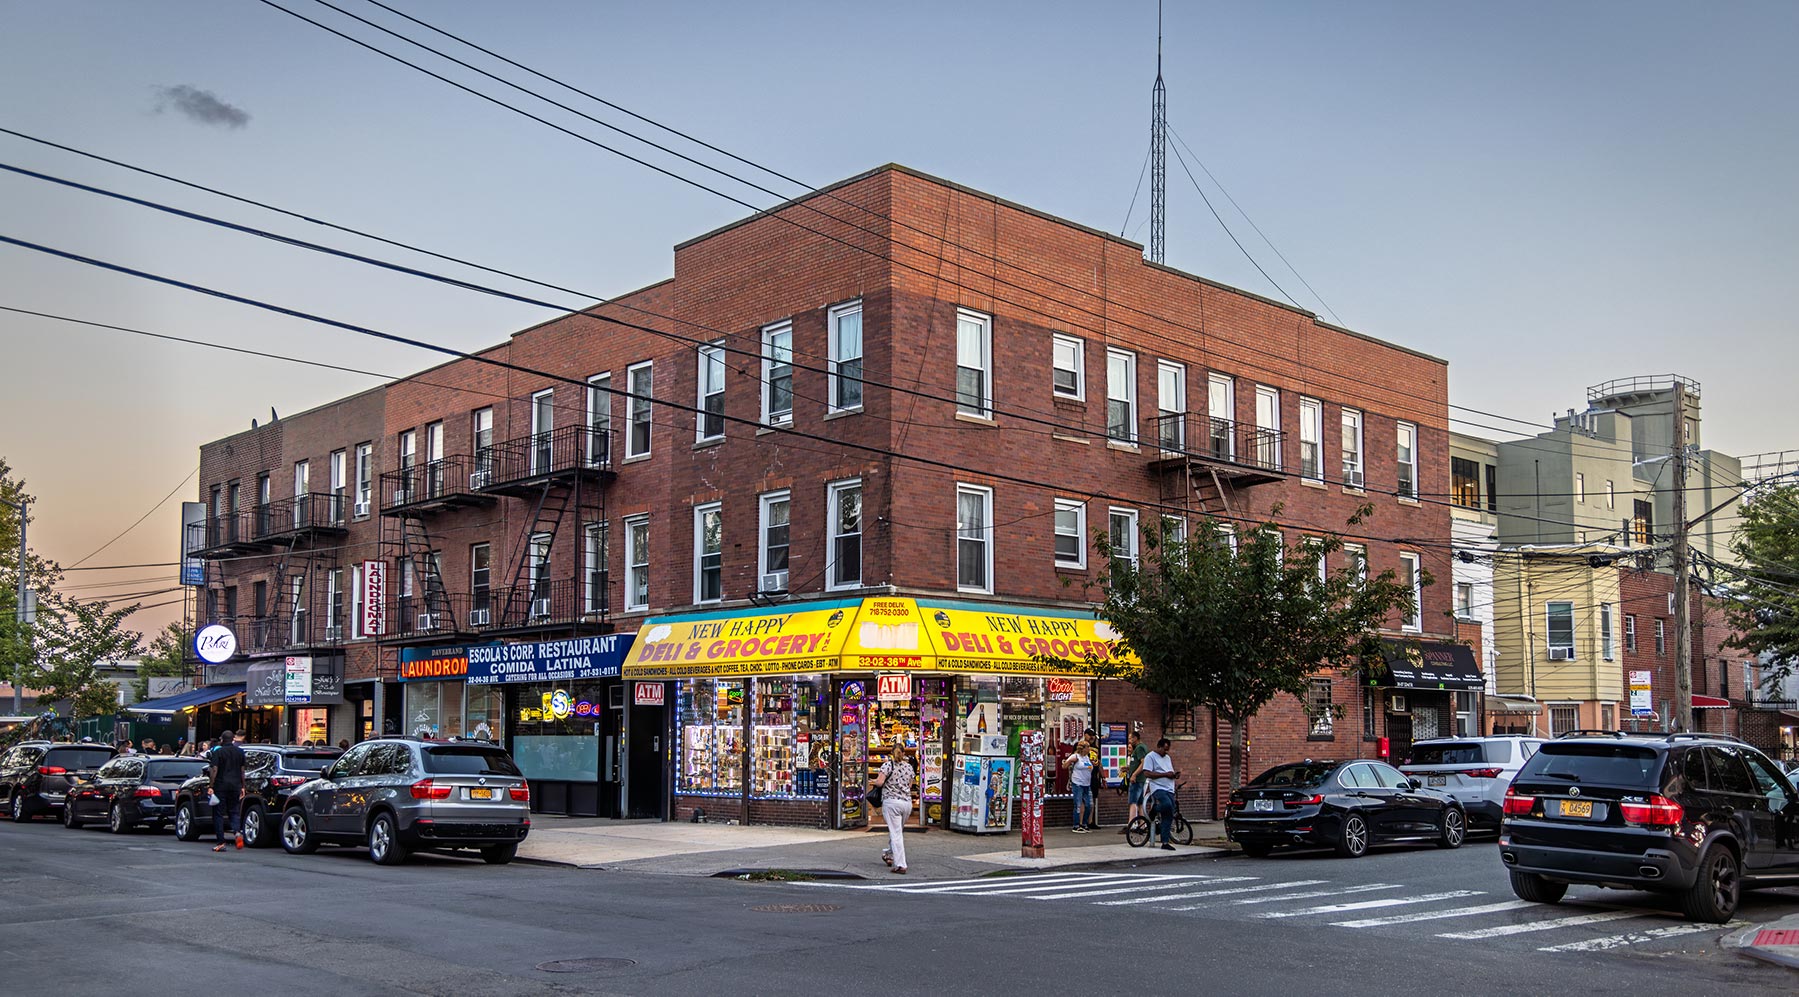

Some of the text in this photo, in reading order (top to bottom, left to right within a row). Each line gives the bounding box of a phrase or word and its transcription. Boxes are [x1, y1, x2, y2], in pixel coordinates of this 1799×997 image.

[368, 563, 382, 633] LAUNDROMAT
[869, 608, 910, 616] 718-752-0300
[688, 614, 793, 640] NEW HAPPY
[985, 615, 1080, 637] NEW HAPPY
[510, 644, 535, 661] CORP.
[538, 635, 617, 660] RESTAURANT
[637, 632, 825, 662] DELI & GROCERY
[941, 631, 994, 653] DELI
[996, 635, 1015, 654] &
[490, 656, 592, 674] COMIDA LATINA
[634, 668, 644, 676] COLD
[644, 667, 667, 676] SANDWICHES
[677, 666, 687, 674] COLD
[687, 665, 711, 674] BEVERAGES
[714, 664, 722, 673] HOT
[782, 661, 797, 670] PHONE
[798, 660, 814, 670] CARDS
[816, 659, 826, 668] EBT
[828, 658, 839, 667] ATM
[938, 659, 948, 668] HOT
[952, 659, 963, 669] COLD
[964, 660, 991, 670] SANDWICHES
[1002, 662, 1012, 670] COLD
[1012, 662, 1036, 672] BEVERAGES
[505, 674, 527, 682] CATERING
[538, 672, 548, 680] ALL
[547, 670, 575, 679] OCCASIONS
[880, 676, 909, 693] ATM
[637, 684, 661, 698] ATM
[1049, 677, 1075, 693] Coors
[1051, 692, 1074, 701] LIGHT
[1568, 803, 1591, 814] 04569
